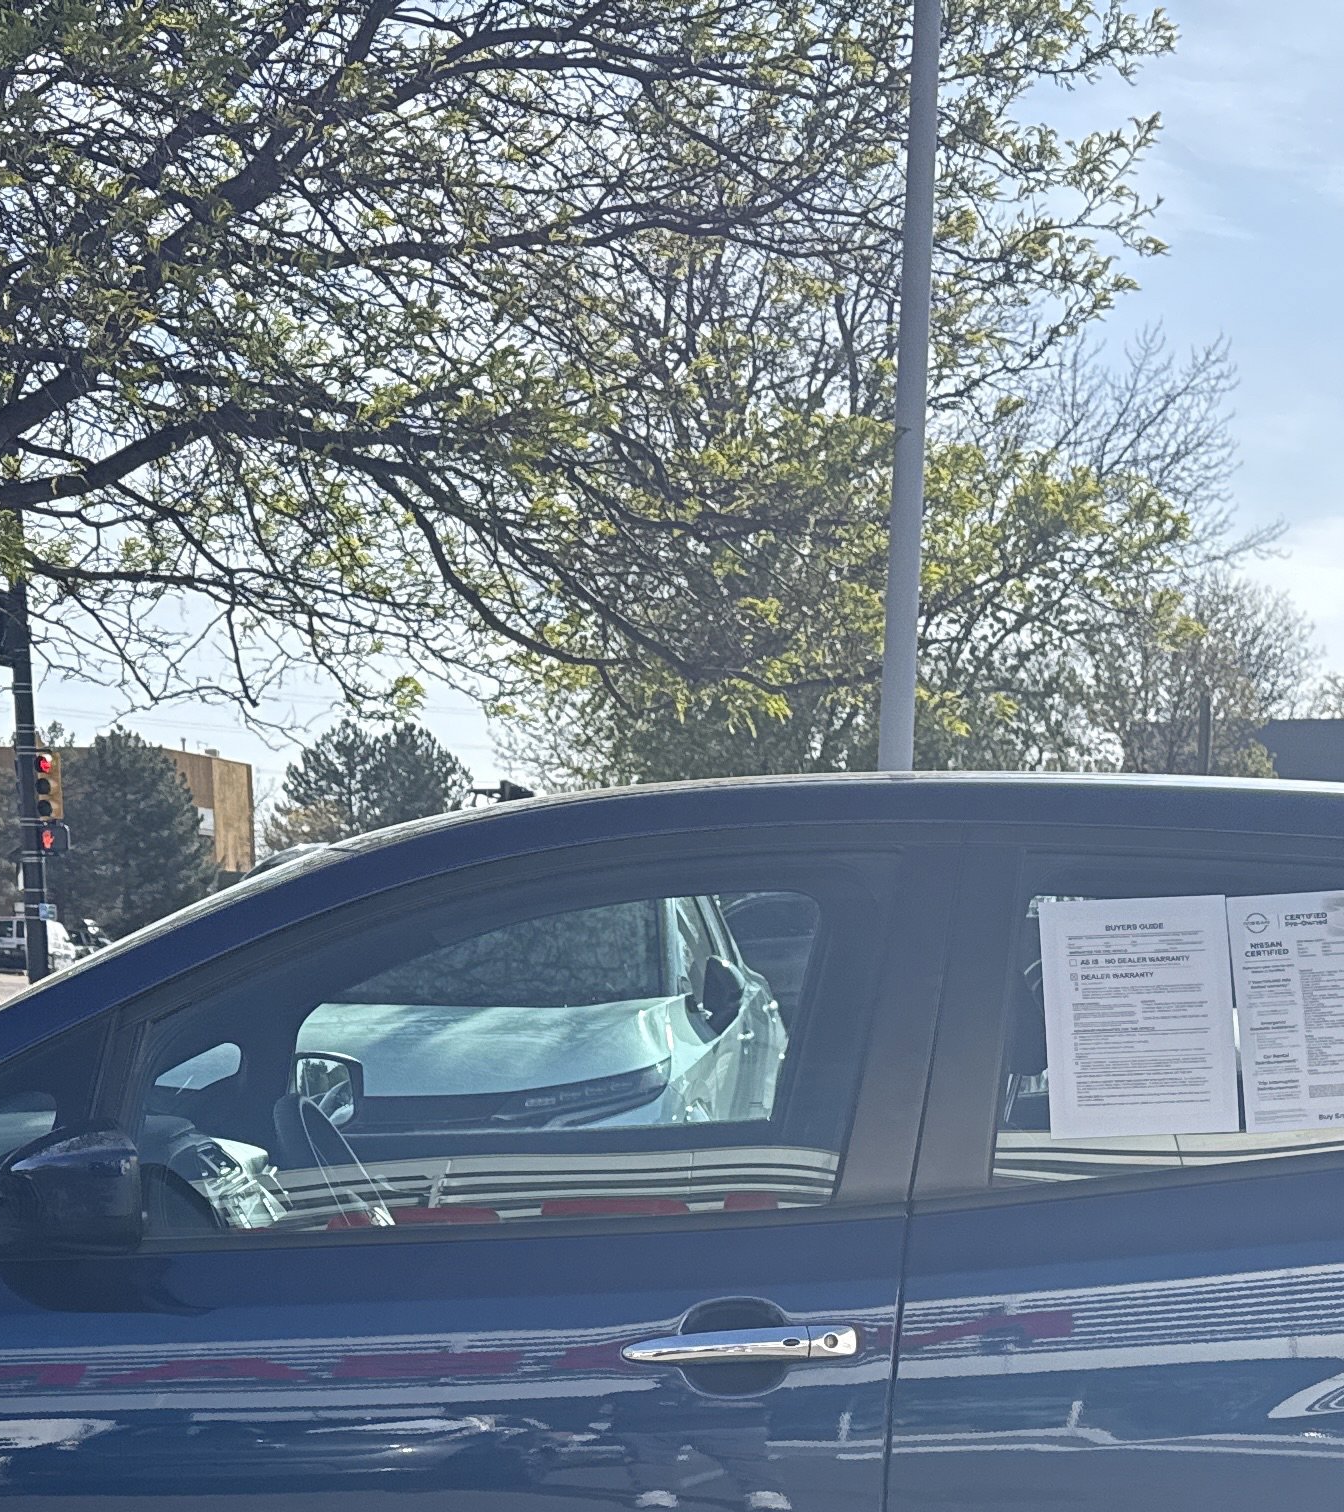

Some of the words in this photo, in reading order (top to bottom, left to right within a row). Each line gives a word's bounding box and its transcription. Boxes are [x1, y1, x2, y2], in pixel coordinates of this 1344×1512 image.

[1284, 912, 1328, 921] CERTIFIED
[1105, 923, 1137, 932] BUYERS
[1139, 922, 1164, 930] GUIDE
[1250, 941, 1283, 949] NISSAN
[1244, 948, 1289, 957] CERTIFIED
[1118, 956, 1147, 964] DEALER
[1148, 954, 1190, 963] WARRANTY
[1081, 973, 1111, 981] DEALER
[1112, 971, 1154, 980] WARRANTY
[1318, 1113, 1333, 1121] Buy
